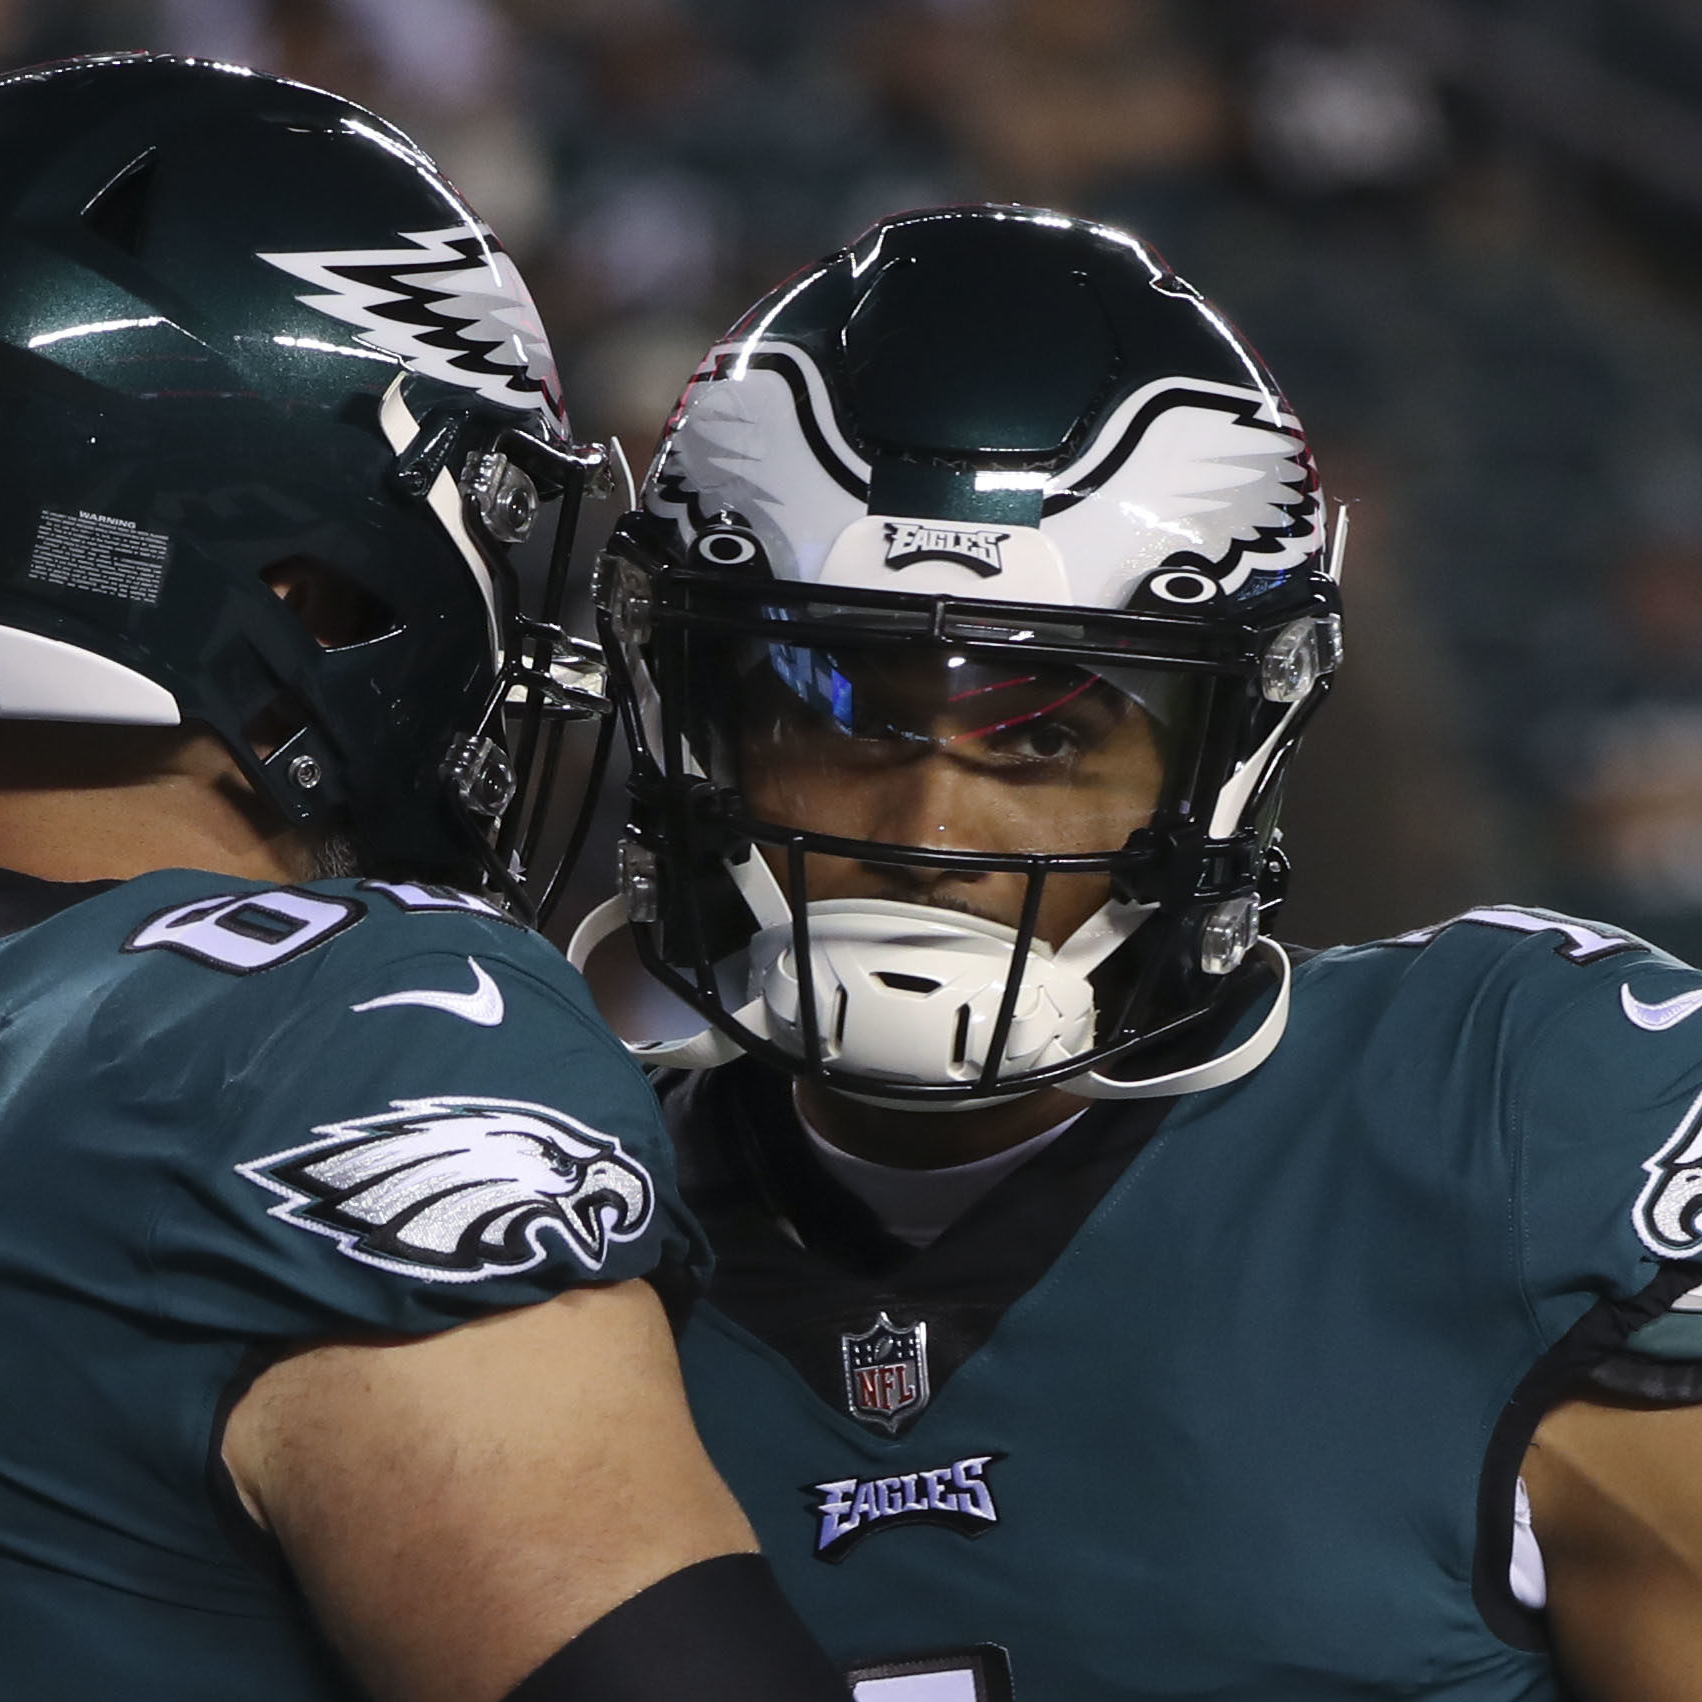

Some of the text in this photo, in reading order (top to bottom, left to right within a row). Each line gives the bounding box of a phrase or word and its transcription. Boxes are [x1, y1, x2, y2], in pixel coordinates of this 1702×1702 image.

[78, 510, 137, 529] WARNING
[884, 522, 1009, 575] EAGLES
[856, 1363, 916, 1411] NFL
[815, 1456, 997, 1550] EAGLES
